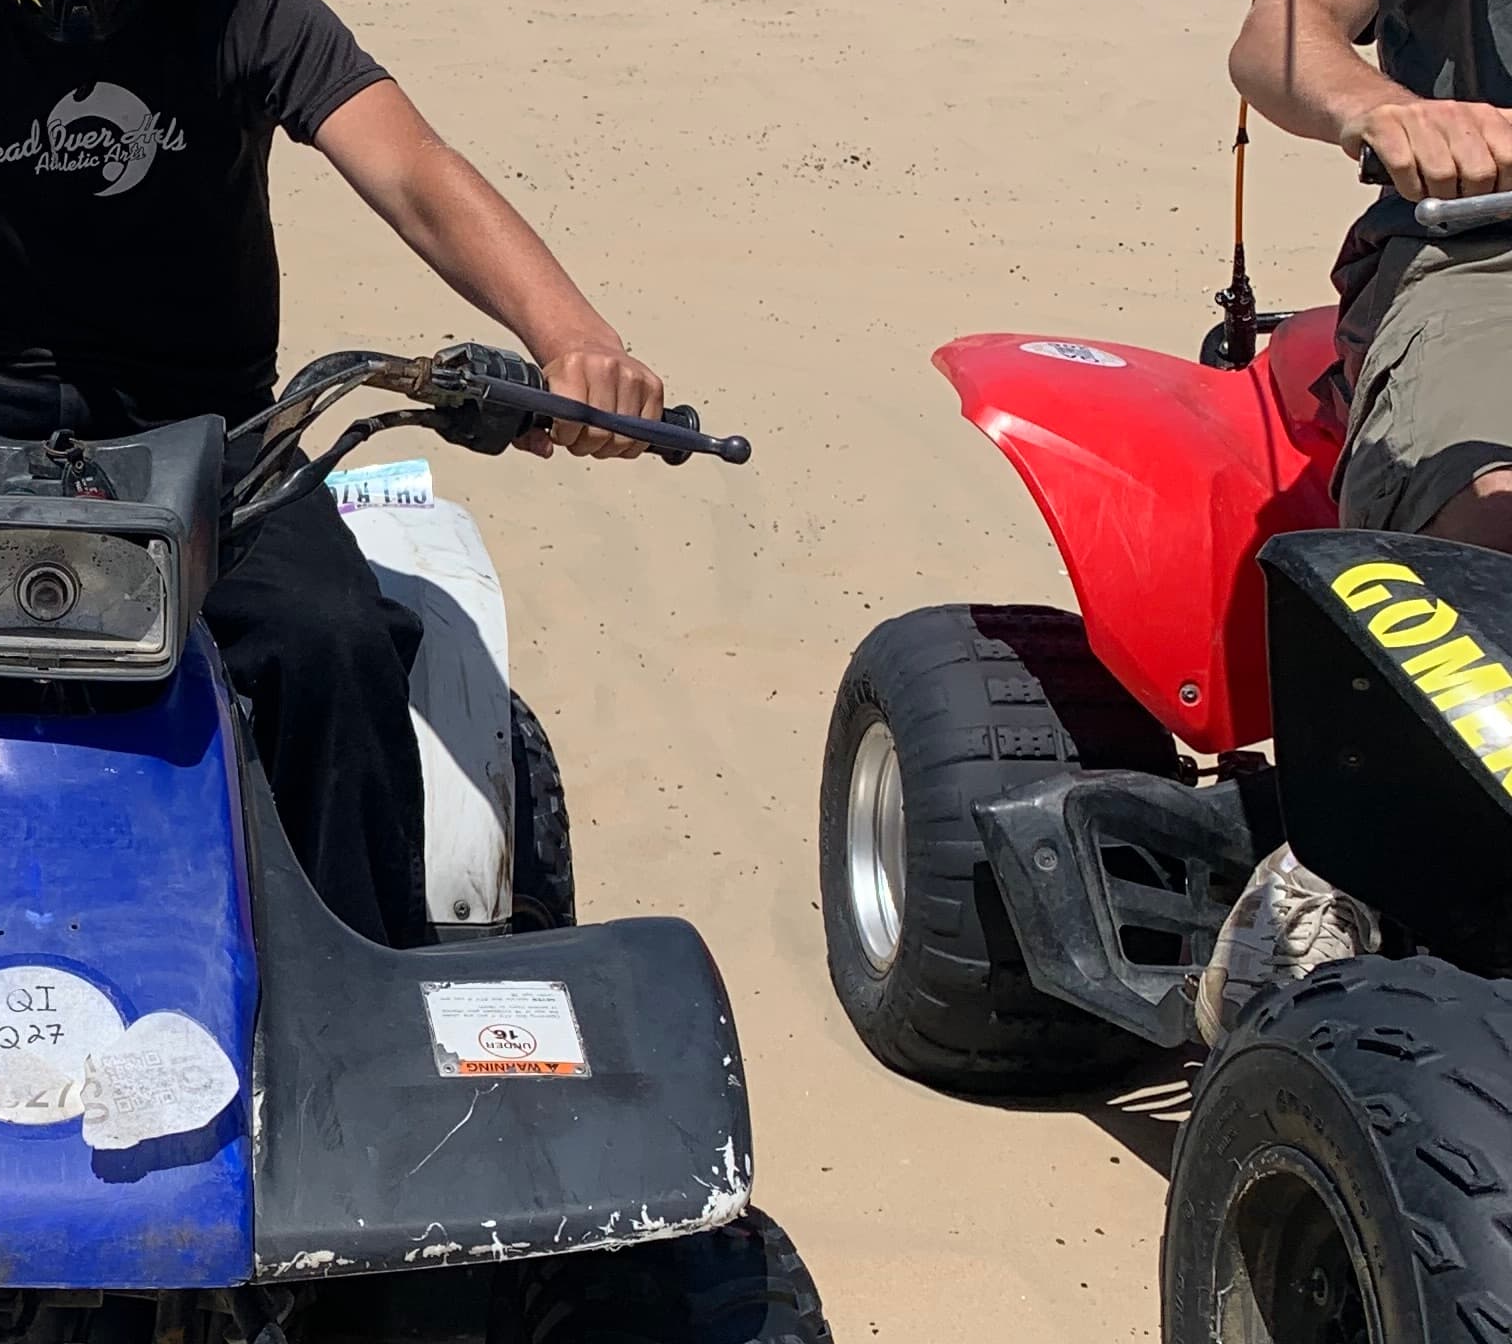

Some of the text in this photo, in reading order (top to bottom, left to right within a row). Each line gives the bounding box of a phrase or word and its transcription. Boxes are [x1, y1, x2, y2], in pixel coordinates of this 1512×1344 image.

[47, 119, 115, 152] Over
[34, 151, 100, 174] Athletic
[494, 1030, 518, 1039] 16
[486, 1041, 531, 1050] UNDER
